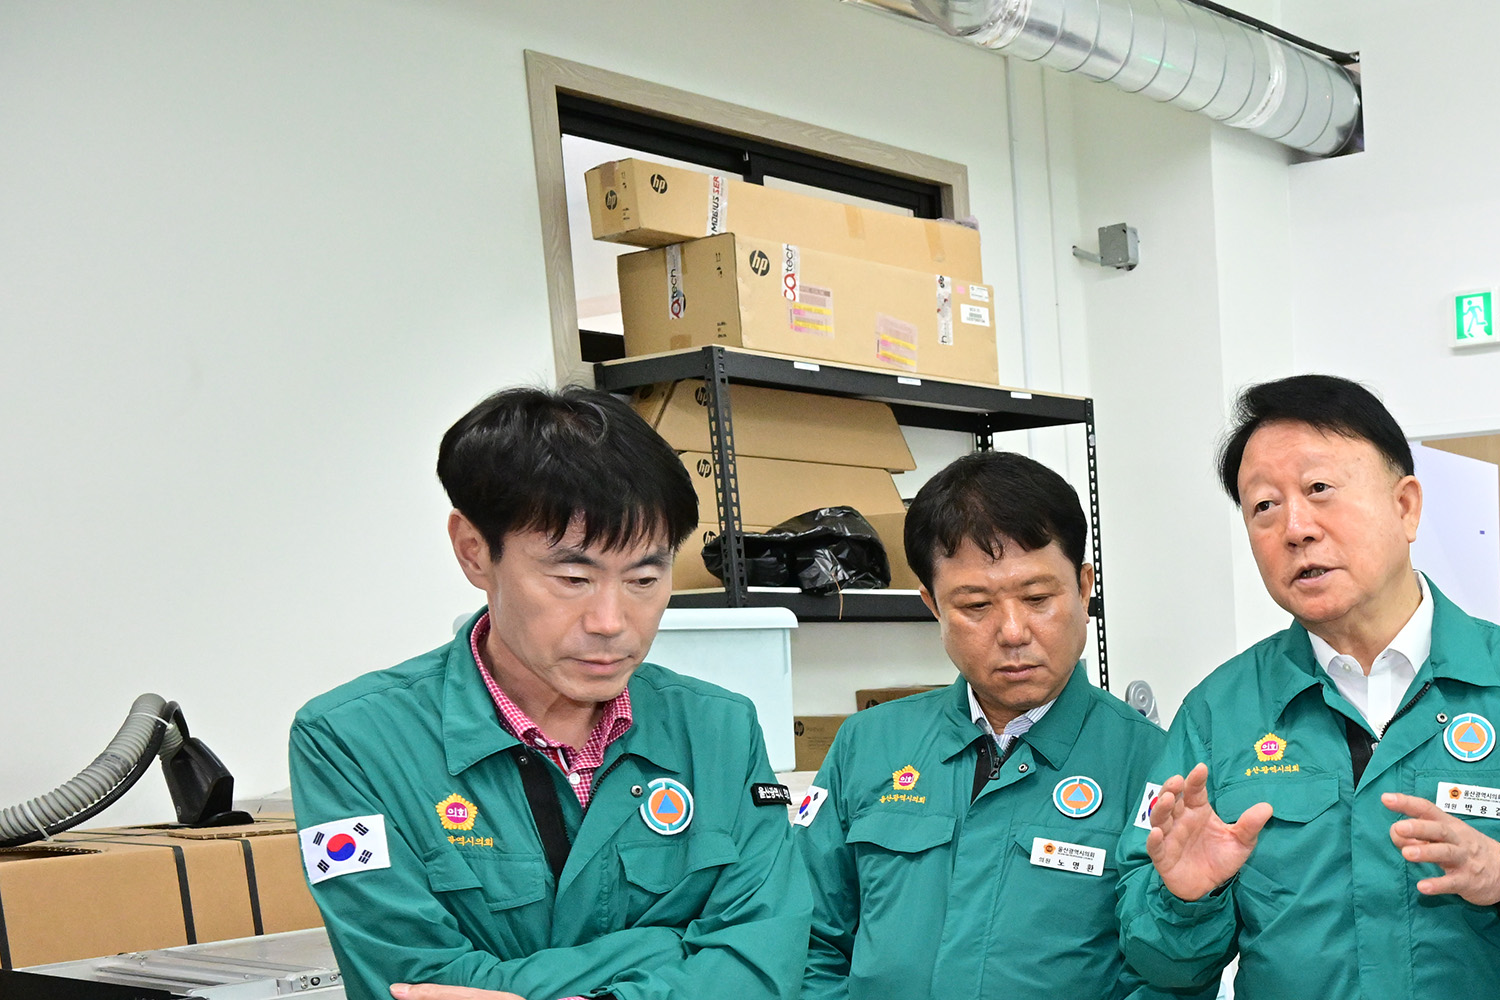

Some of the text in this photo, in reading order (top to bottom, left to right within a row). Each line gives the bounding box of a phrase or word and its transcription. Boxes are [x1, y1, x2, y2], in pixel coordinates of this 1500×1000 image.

[651, 174, 668, 194] hp
[711, 196, 720, 232] MOBIUS
[750, 250, 770, 276] hp
[697, 459, 711, 478] hp
[1261, 743, 1279, 751] 의회
[1245, 764, 1300, 776] 울산광역시의회
[1444, 802, 1457, 810] 의원
[446, 807, 468, 818] 의회
[1057, 846, 1096, 858] 울산광역시의회
[1038, 856, 1051, 864] 의원
